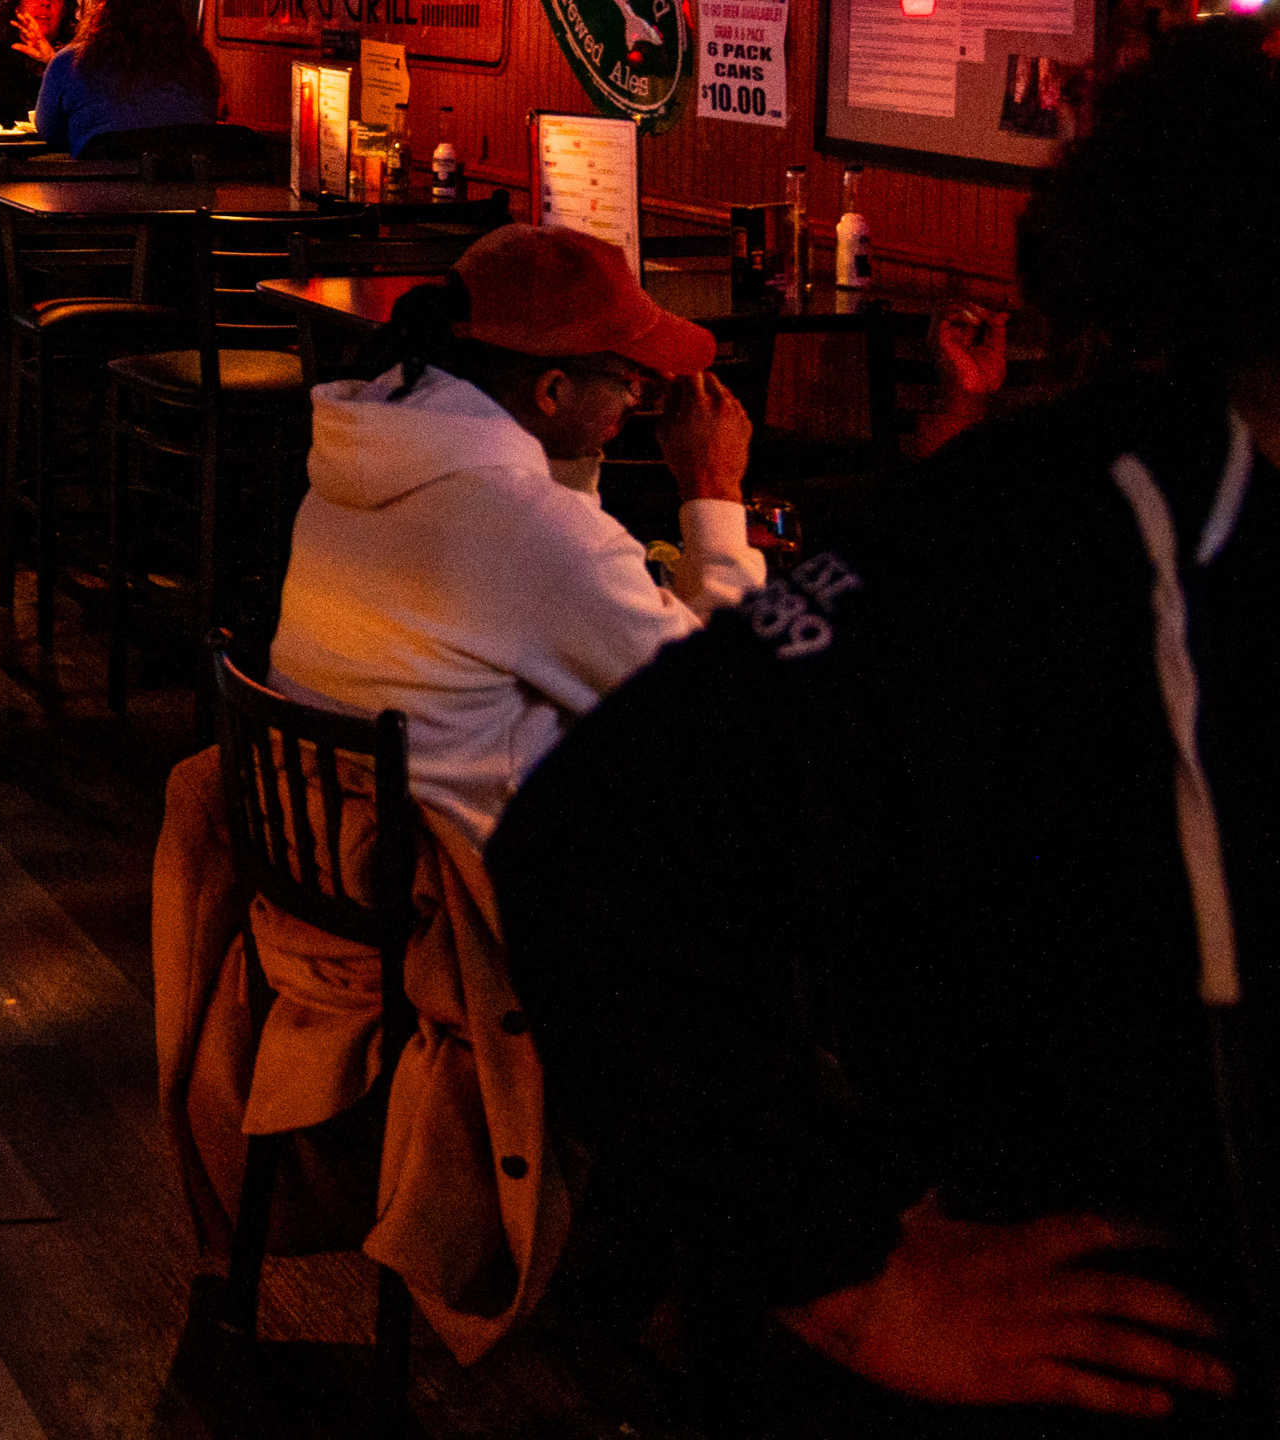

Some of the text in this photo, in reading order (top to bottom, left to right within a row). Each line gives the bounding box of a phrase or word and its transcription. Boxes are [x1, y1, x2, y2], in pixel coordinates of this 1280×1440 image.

[707, 41, 773, 62] 6 PACK
[608, 60, 650, 96] Ales
[714, 62, 765, 81] CANS
[702, 82, 767, 116] $10.00
